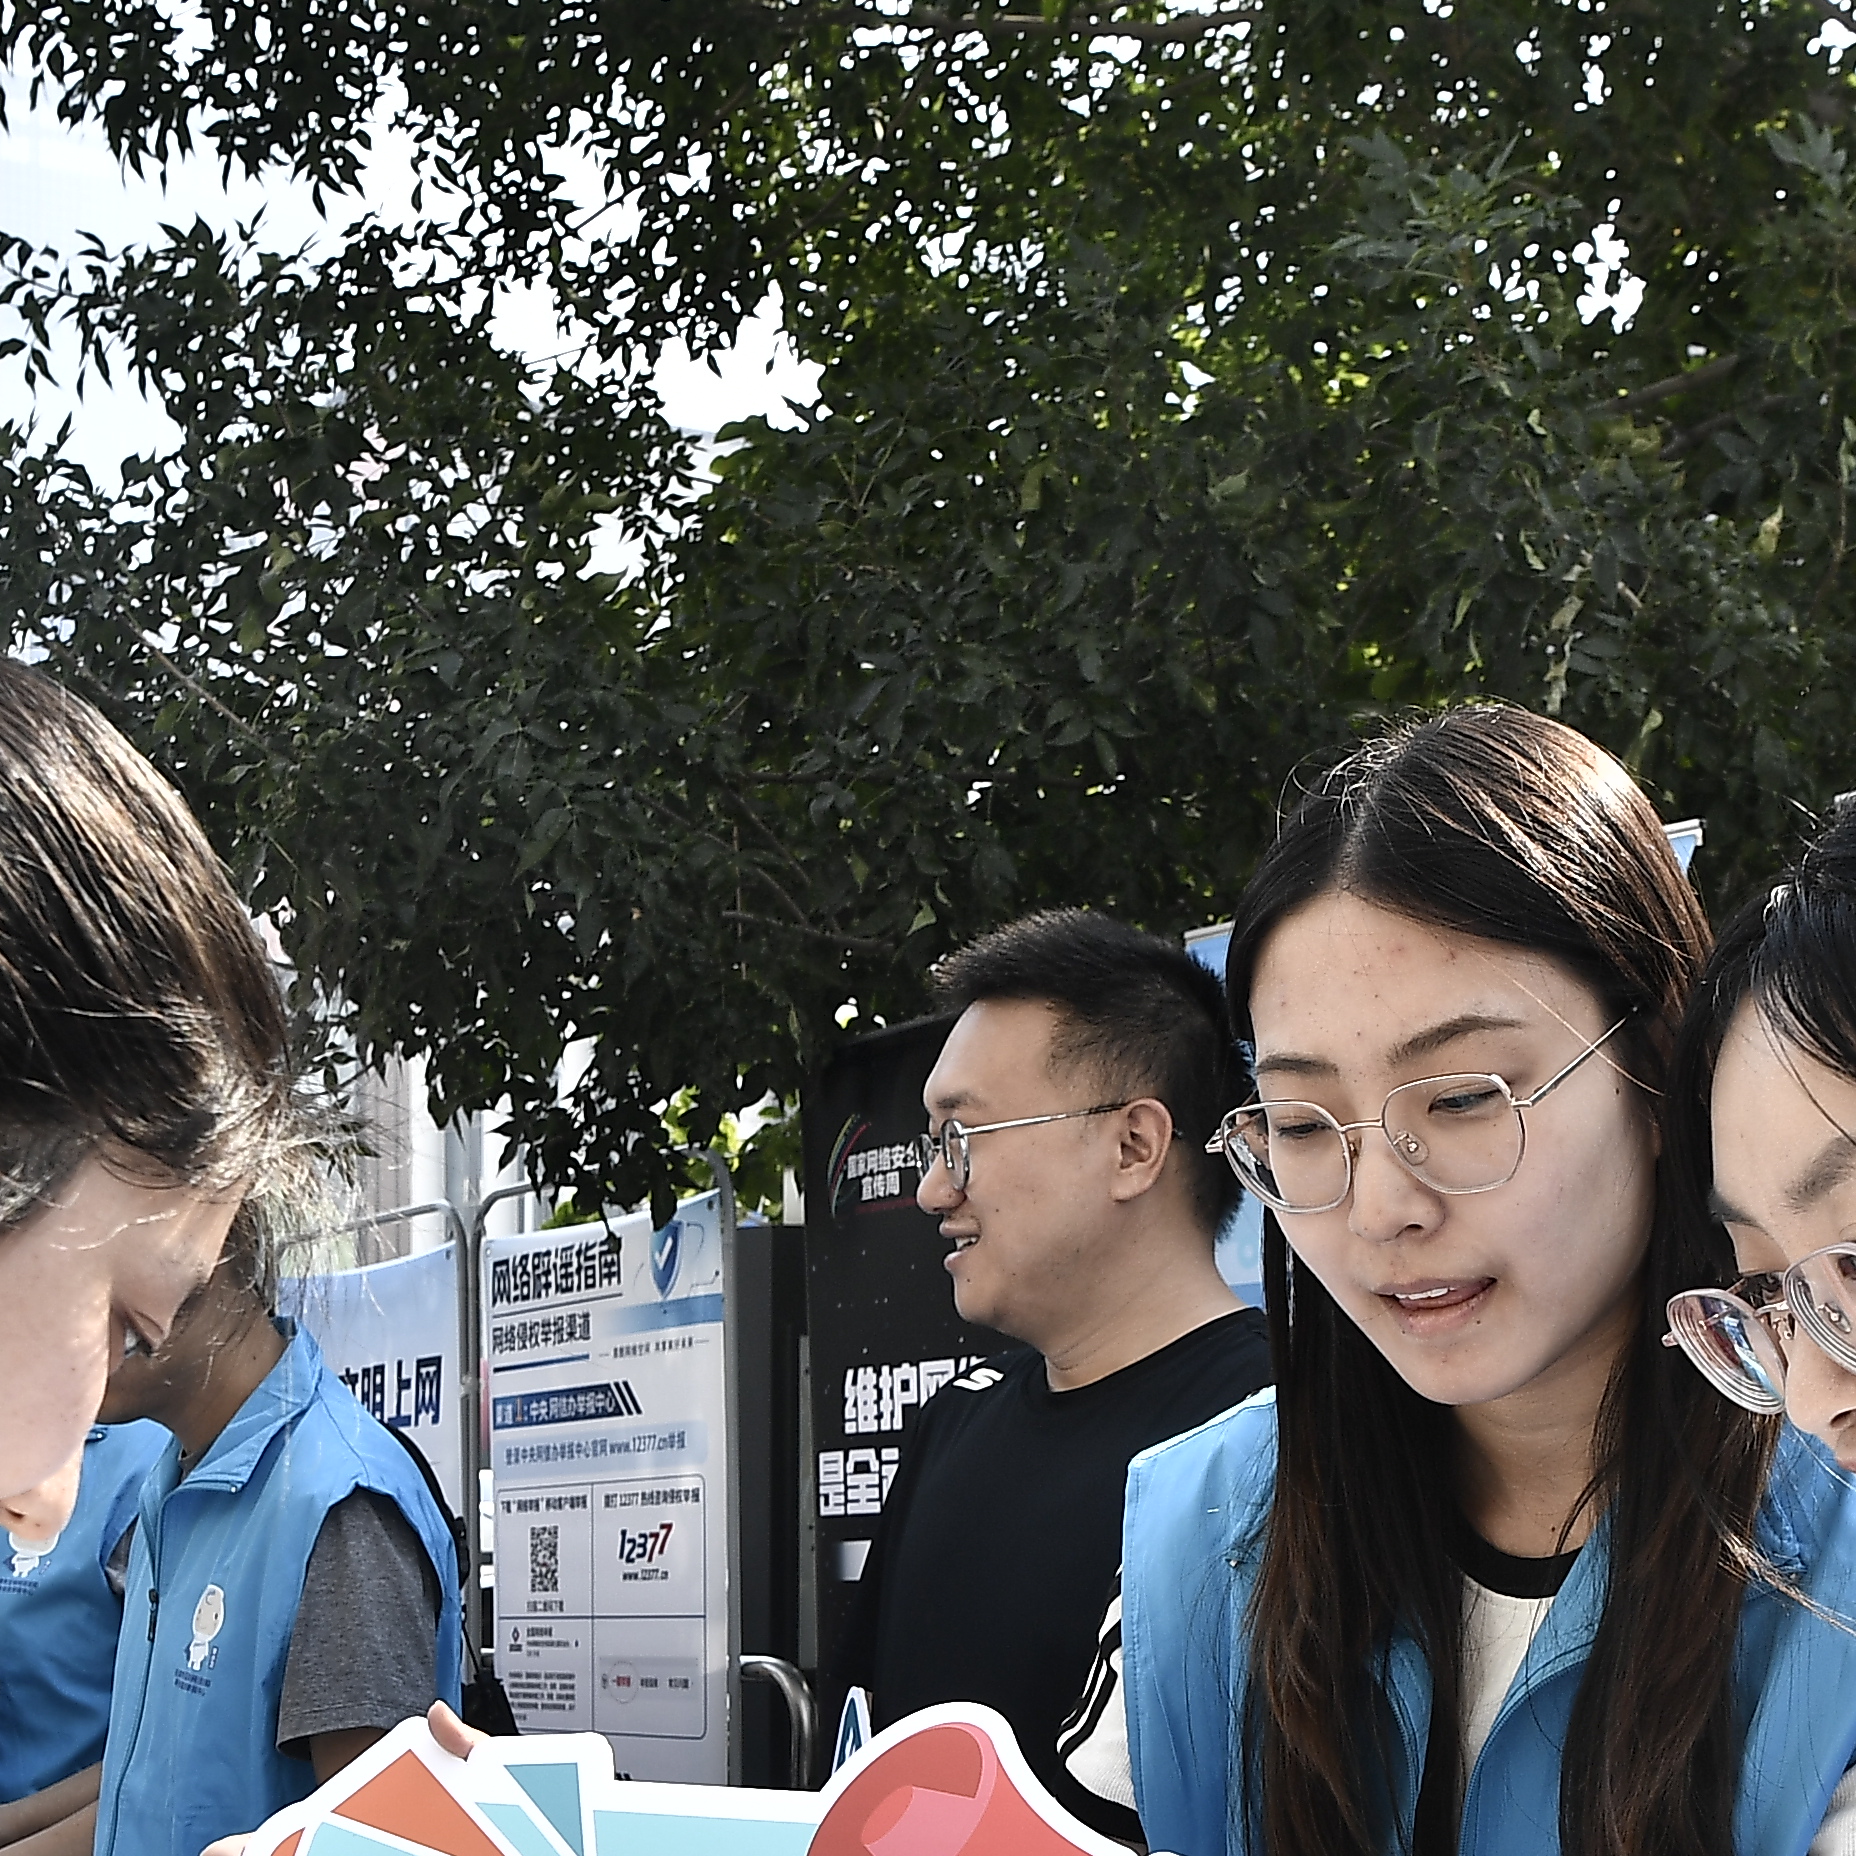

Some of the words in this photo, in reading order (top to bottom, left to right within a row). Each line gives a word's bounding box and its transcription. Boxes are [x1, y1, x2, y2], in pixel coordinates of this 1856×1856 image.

[492, 1312, 591, 1355] 网络侵权举报渠道
[844, 1355, 988, 1434] 维护网
[618, 1522, 674, 1563] 12377
